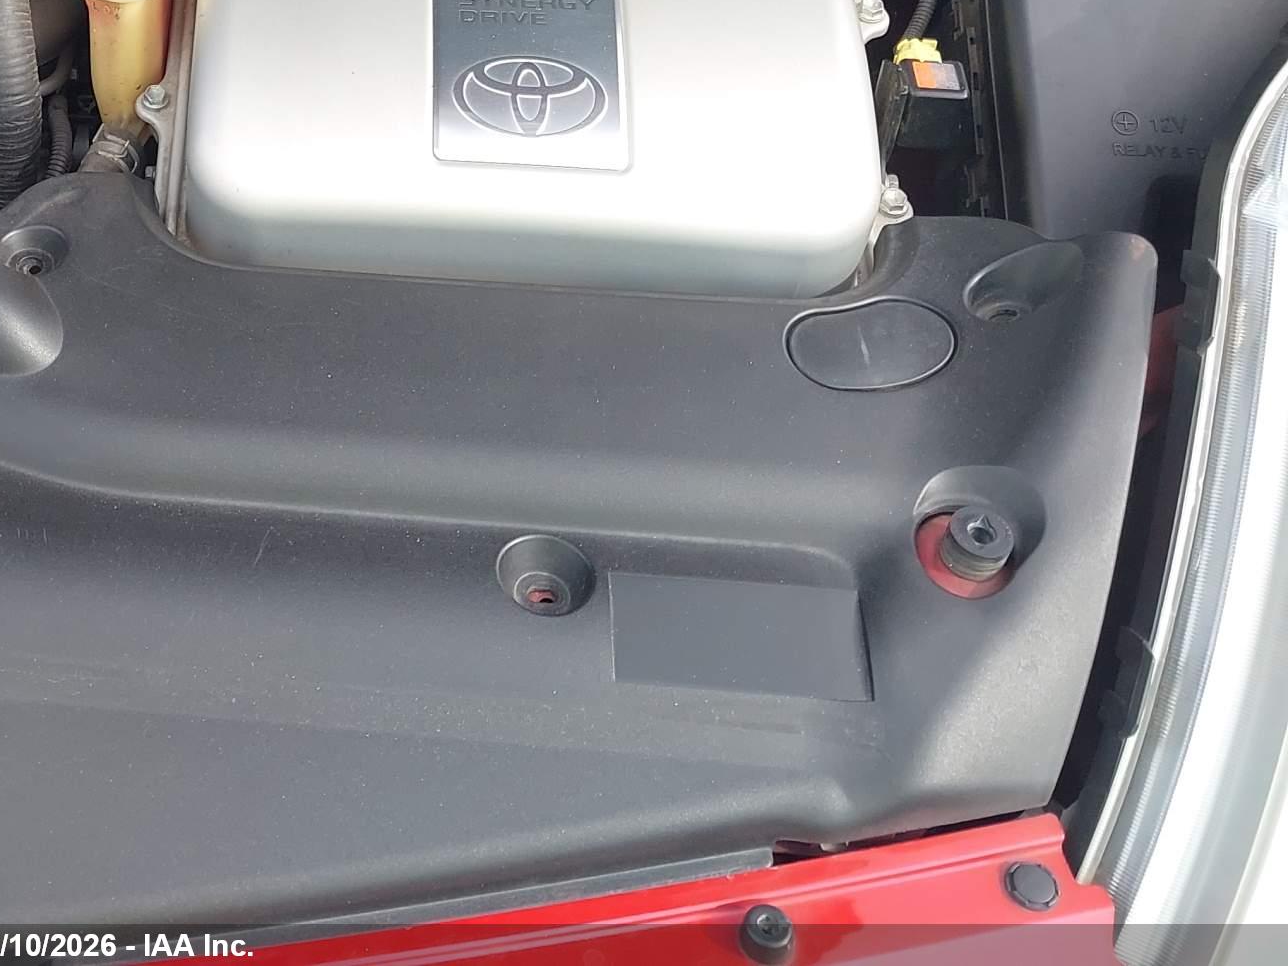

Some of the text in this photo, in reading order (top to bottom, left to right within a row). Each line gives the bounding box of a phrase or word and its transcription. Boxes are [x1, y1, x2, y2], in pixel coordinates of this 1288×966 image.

[458, 9, 548, 26] DRIVE
[1149, 114, 1188, 135] 12V
[1113, 141, 1168, 158] RELAY
